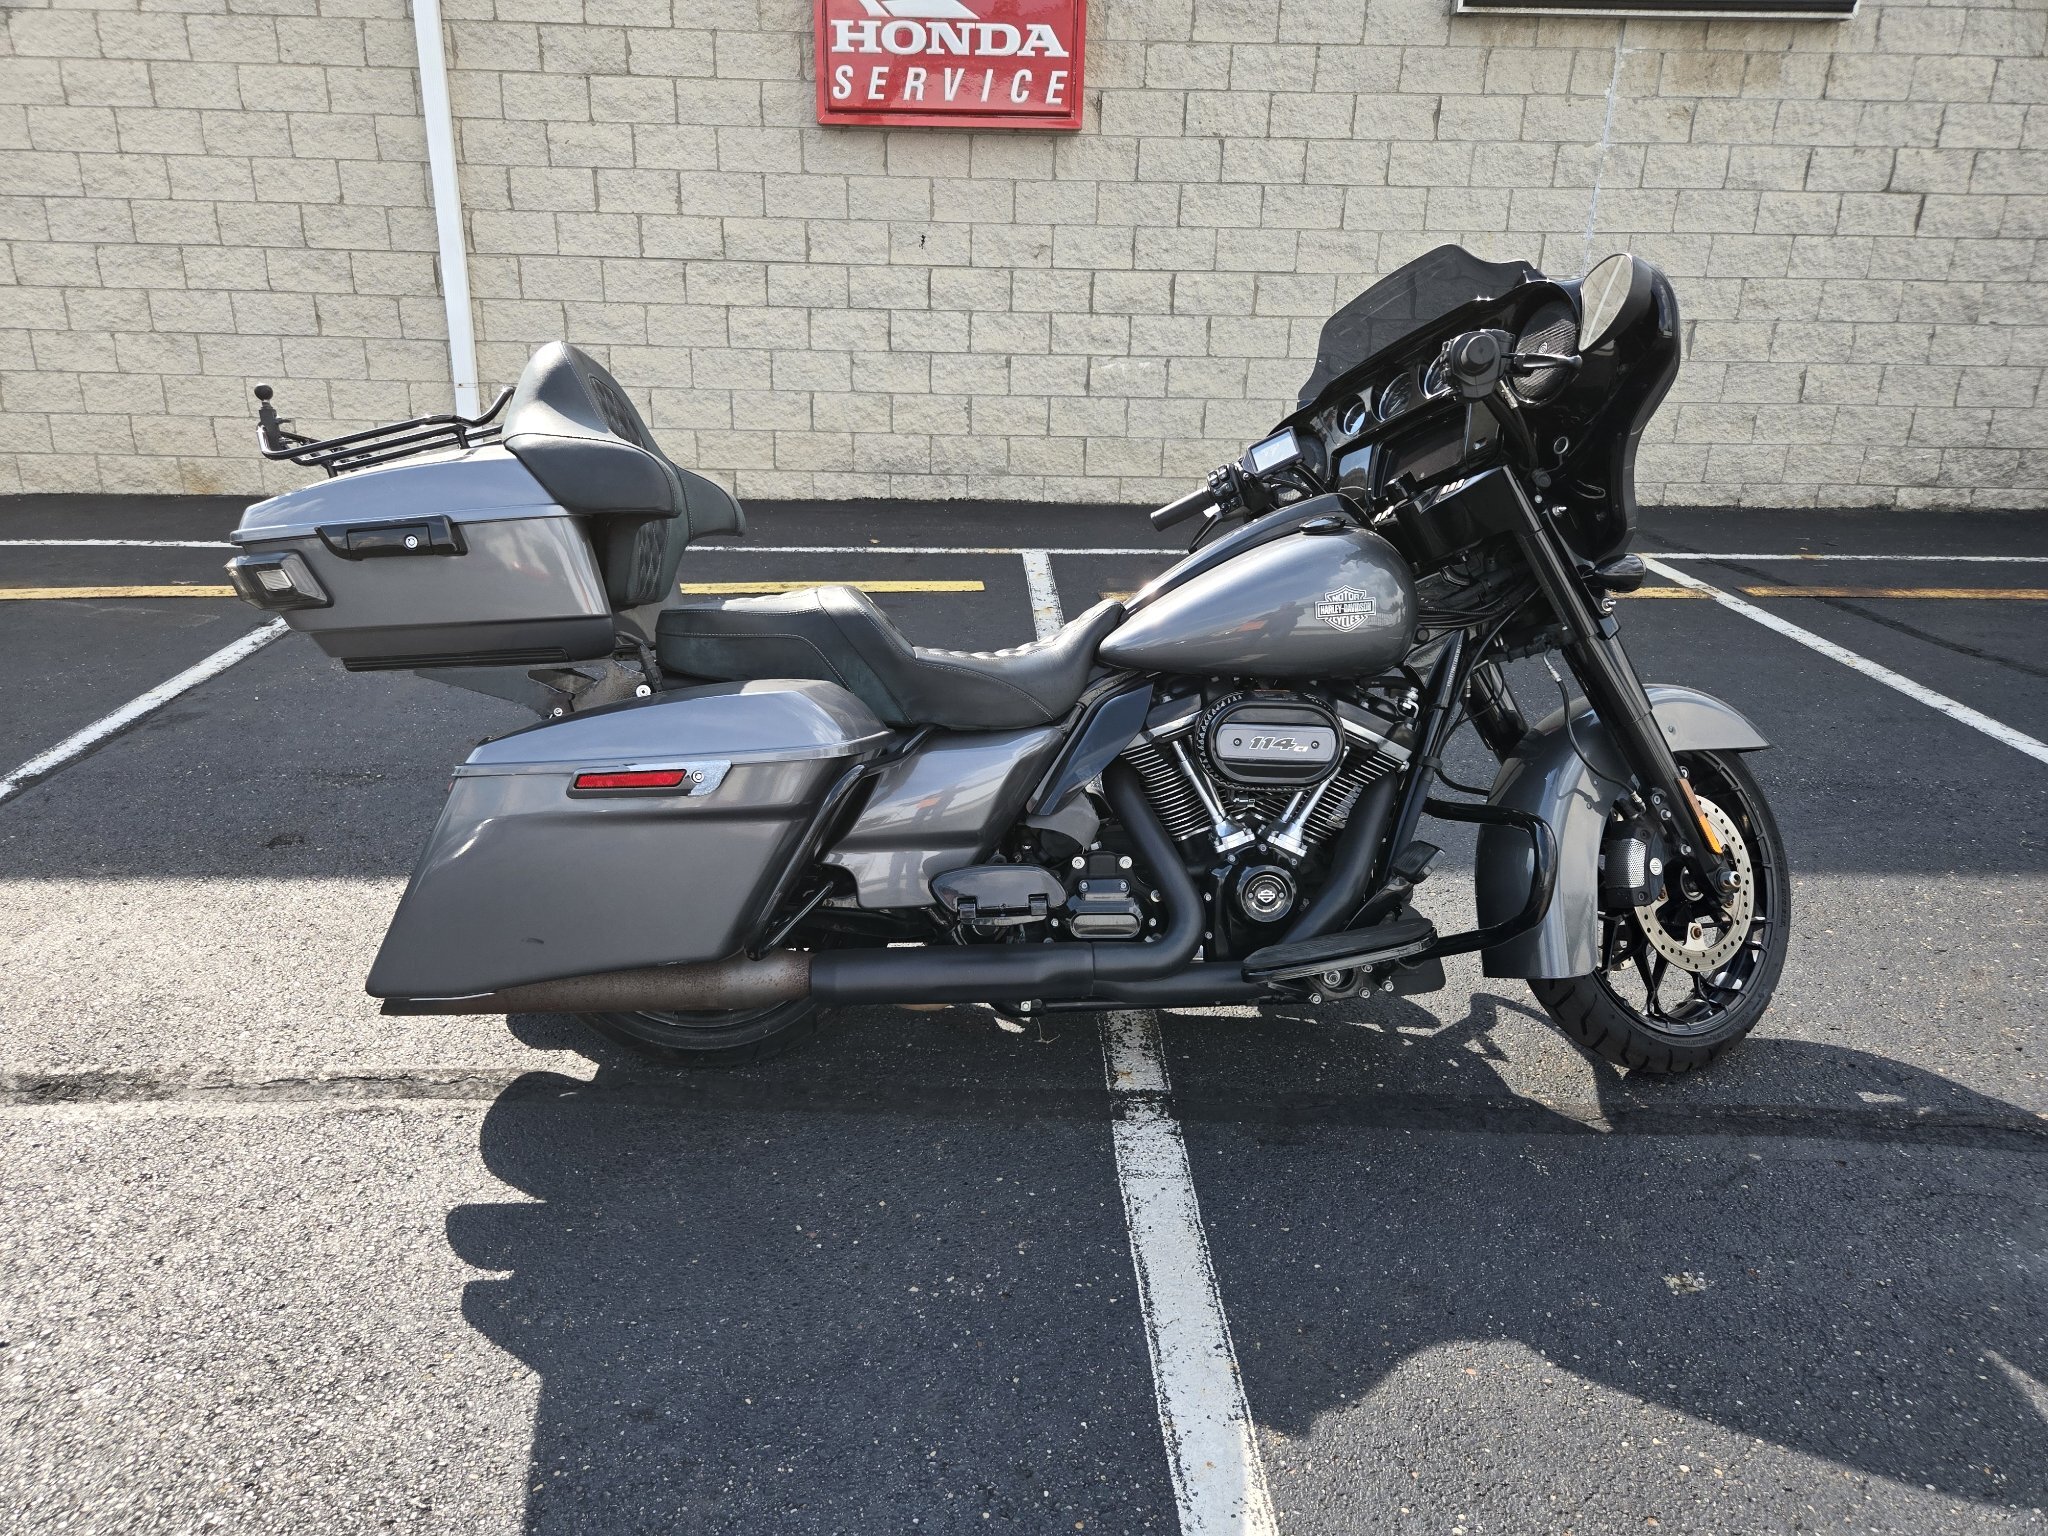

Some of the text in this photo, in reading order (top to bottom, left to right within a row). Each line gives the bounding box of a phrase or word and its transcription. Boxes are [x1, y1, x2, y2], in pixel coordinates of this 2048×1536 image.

[831, 19, 1069, 57] HONDA
[832, 65, 1068, 105] SERVICE
[1332, 591, 1360, 601] MOTOR
[1320, 602, 1371, 615] HARLEY-DAVIDSON
[1332, 615, 1360, 627] CYCLES
